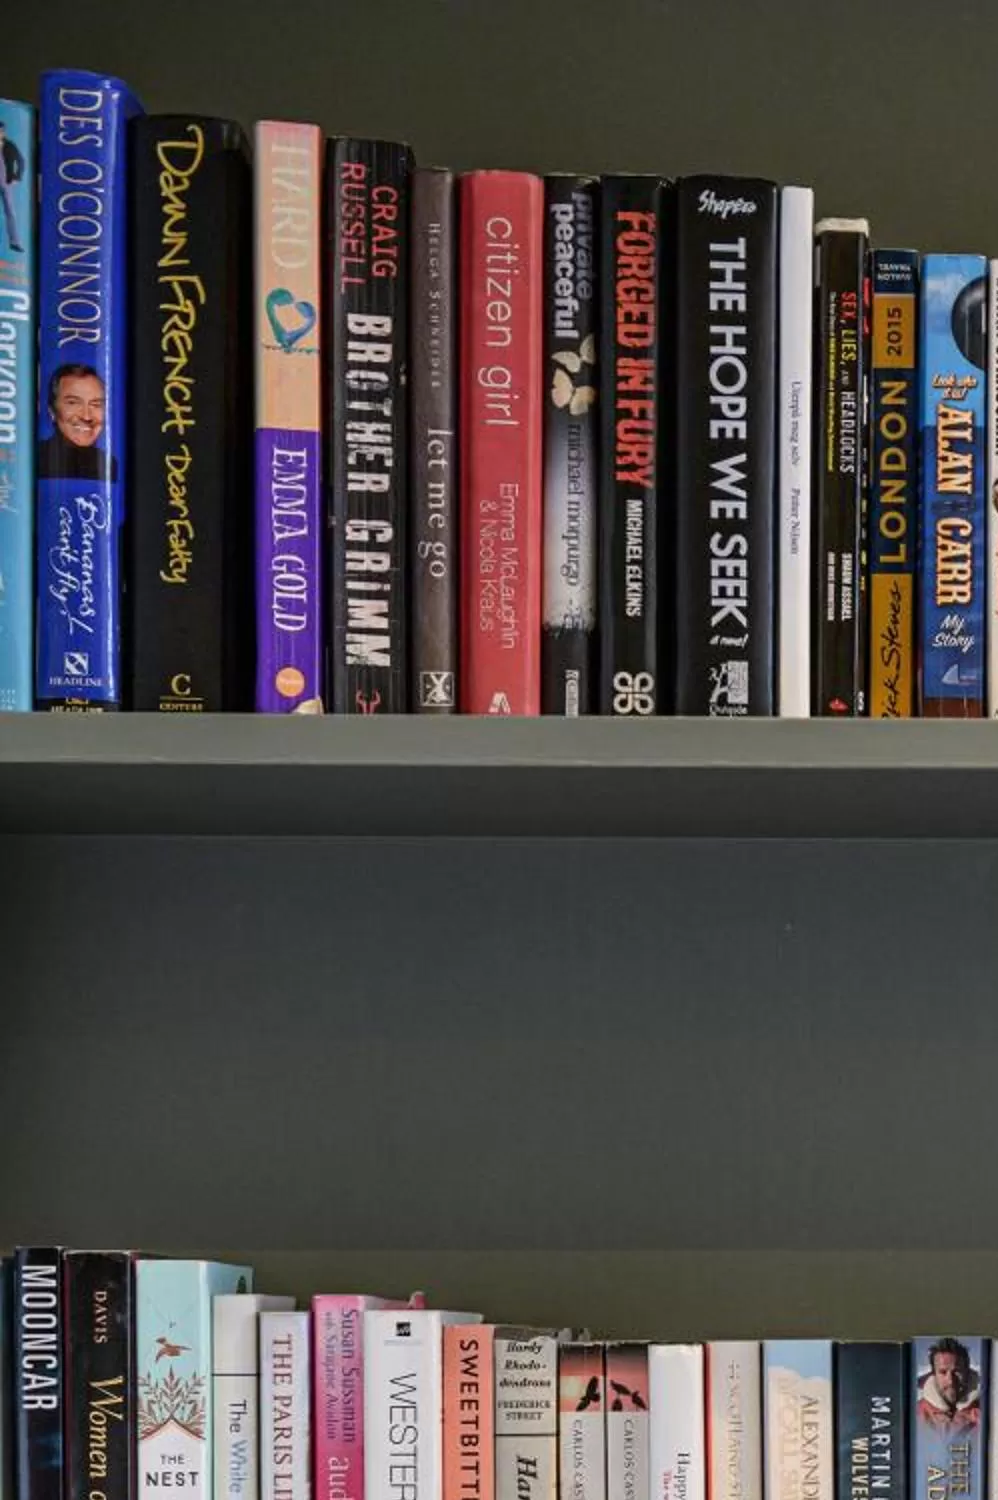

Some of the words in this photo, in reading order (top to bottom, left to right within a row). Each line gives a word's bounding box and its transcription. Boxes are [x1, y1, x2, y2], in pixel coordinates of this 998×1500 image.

[58, 88, 103, 146] DES
[56, 158, 103, 348] O'CONNOR
[341, 161, 366, 296] RUSSELL
[371, 186, 398, 278] CRAIG
[484, 217, 518, 347] citizen
[550, 203, 579, 339] peaceful
[613, 210, 655, 347] FORGED
[709, 236, 748, 312] THE
[885, 306, 902, 358] 2015
[344, 313, 395, 494] BROTHER
[474, 365, 519, 426] girl
[613, 358, 655, 393] IN
[709, 324, 748, 439] HOPE
[428, 427, 454, 469] let
[613, 400, 655, 490] FURY
[880, 379, 909, 565] LONDON
[935, 403, 974, 494] ALAN
[272, 446, 308, 543] EMMA
[428, 481, 449, 531] me
[709, 452, 748, 519] WE
[418, 541, 449, 579] go
[625, 499, 643, 562] MICHAEL
[935, 517, 974, 606] CARR
[272, 553, 308, 632] GOLD
[625, 564, 643, 617] ELKINS
[709, 532, 748, 627] SEEK
[21, 1264, 58, 1411] MOONCAR
[273, 1334, 293, 1389] THE
[340, 1307, 360, 1361] Susan
[88, 1375, 127, 1479] Women
[228, 1399, 248, 1434] The
[273, 1394, 293, 1465] PARIS
[340, 1367, 360, 1444] Sussman
[871, 1396, 893, 1489] MARTIN
[145, 1471, 200, 1487] NEST
[228, 1439, 248, 1494] White
